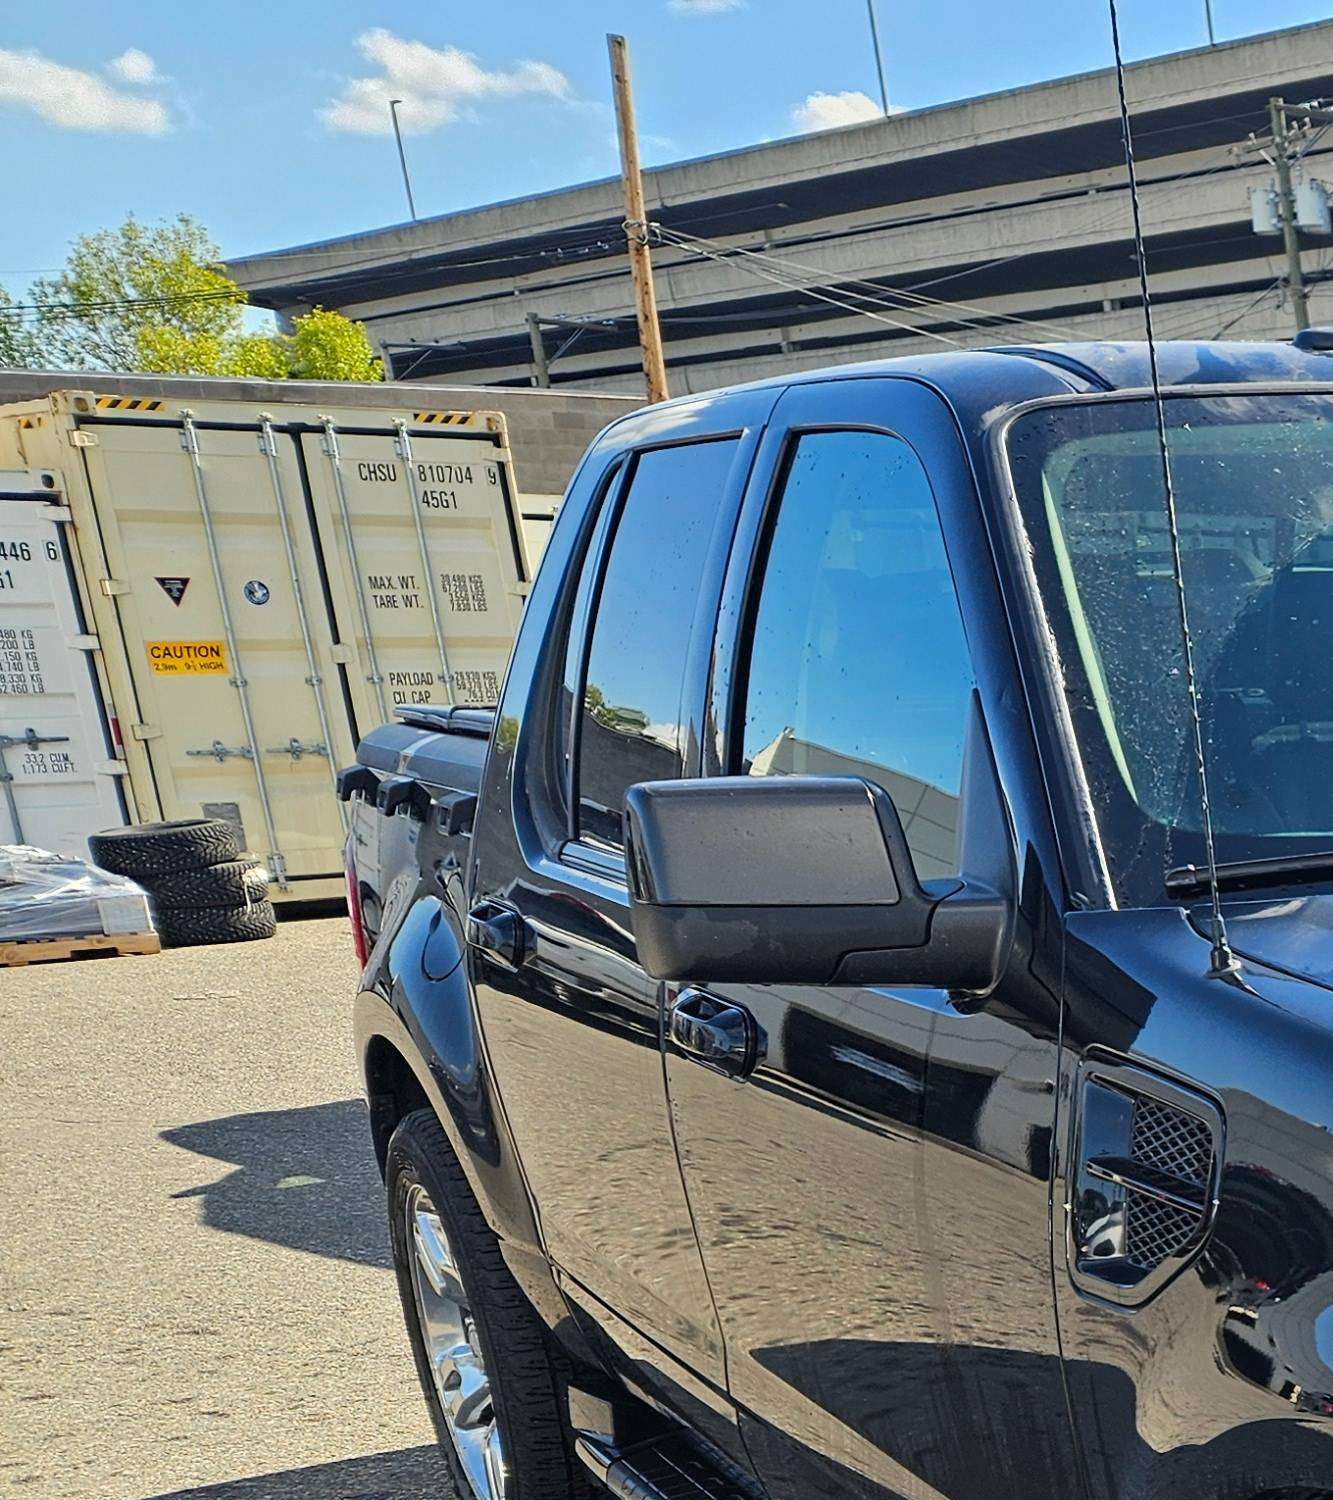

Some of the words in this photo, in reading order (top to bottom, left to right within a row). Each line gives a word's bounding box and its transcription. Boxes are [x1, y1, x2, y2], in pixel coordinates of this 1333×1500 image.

[358, 463, 397, 482] CHSU
[417, 464, 473, 484] 810704
[422, 490, 457, 509] 45G1
[46, 541, 57, 560] 6
[372, 594, 399, 608] TARE
[20, 629, 33, 639] KG
[23, 639, 35, 650] LB
[25, 651, 38, 661] KG
[150, 645, 221, 659] CAUTION
[28, 661, 40, 672] LB
[389, 672, 433, 686] PAYLOAD
[32, 683, 45, 694] LB
